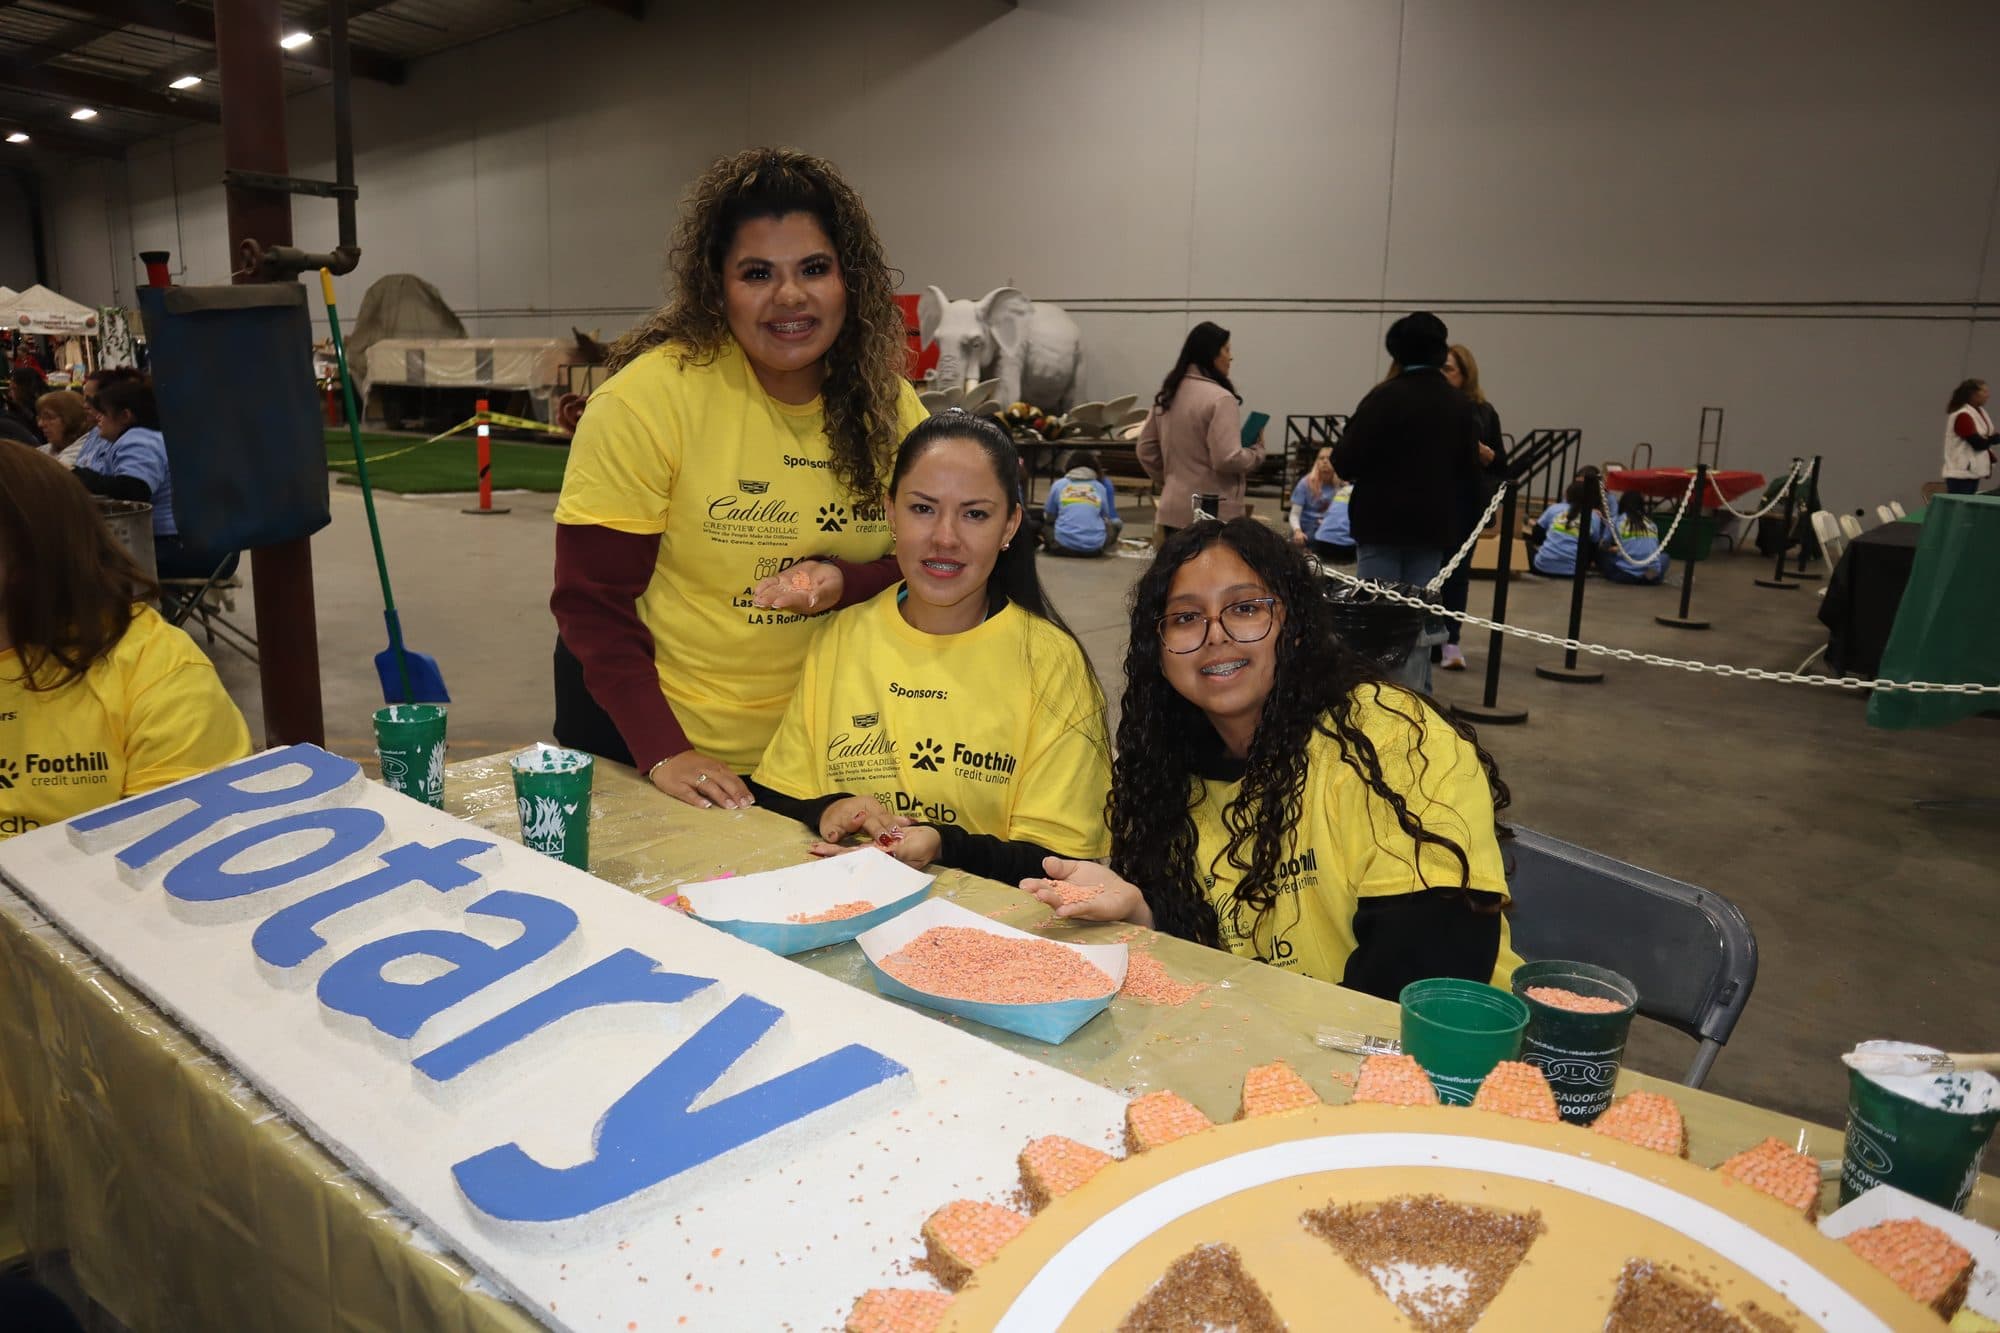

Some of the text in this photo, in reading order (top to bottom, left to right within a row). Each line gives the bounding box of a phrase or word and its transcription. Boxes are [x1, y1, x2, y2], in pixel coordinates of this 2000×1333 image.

[706, 495, 799, 523] Cadillac
[703, 521, 799, 535] CRESTVIEW CADILLAC
[748, 614, 764, 625] LA
[767, 614, 774, 625] 5
[889, 682, 948, 700] Sponsors:
[25, 751, 109, 773] Foothill
[953, 742, 1017, 776] Foothill
[31, 774, 108, 786] credit union
[955, 767, 1011, 785] credit union
[66, 743, 911, 1224] Rotary
